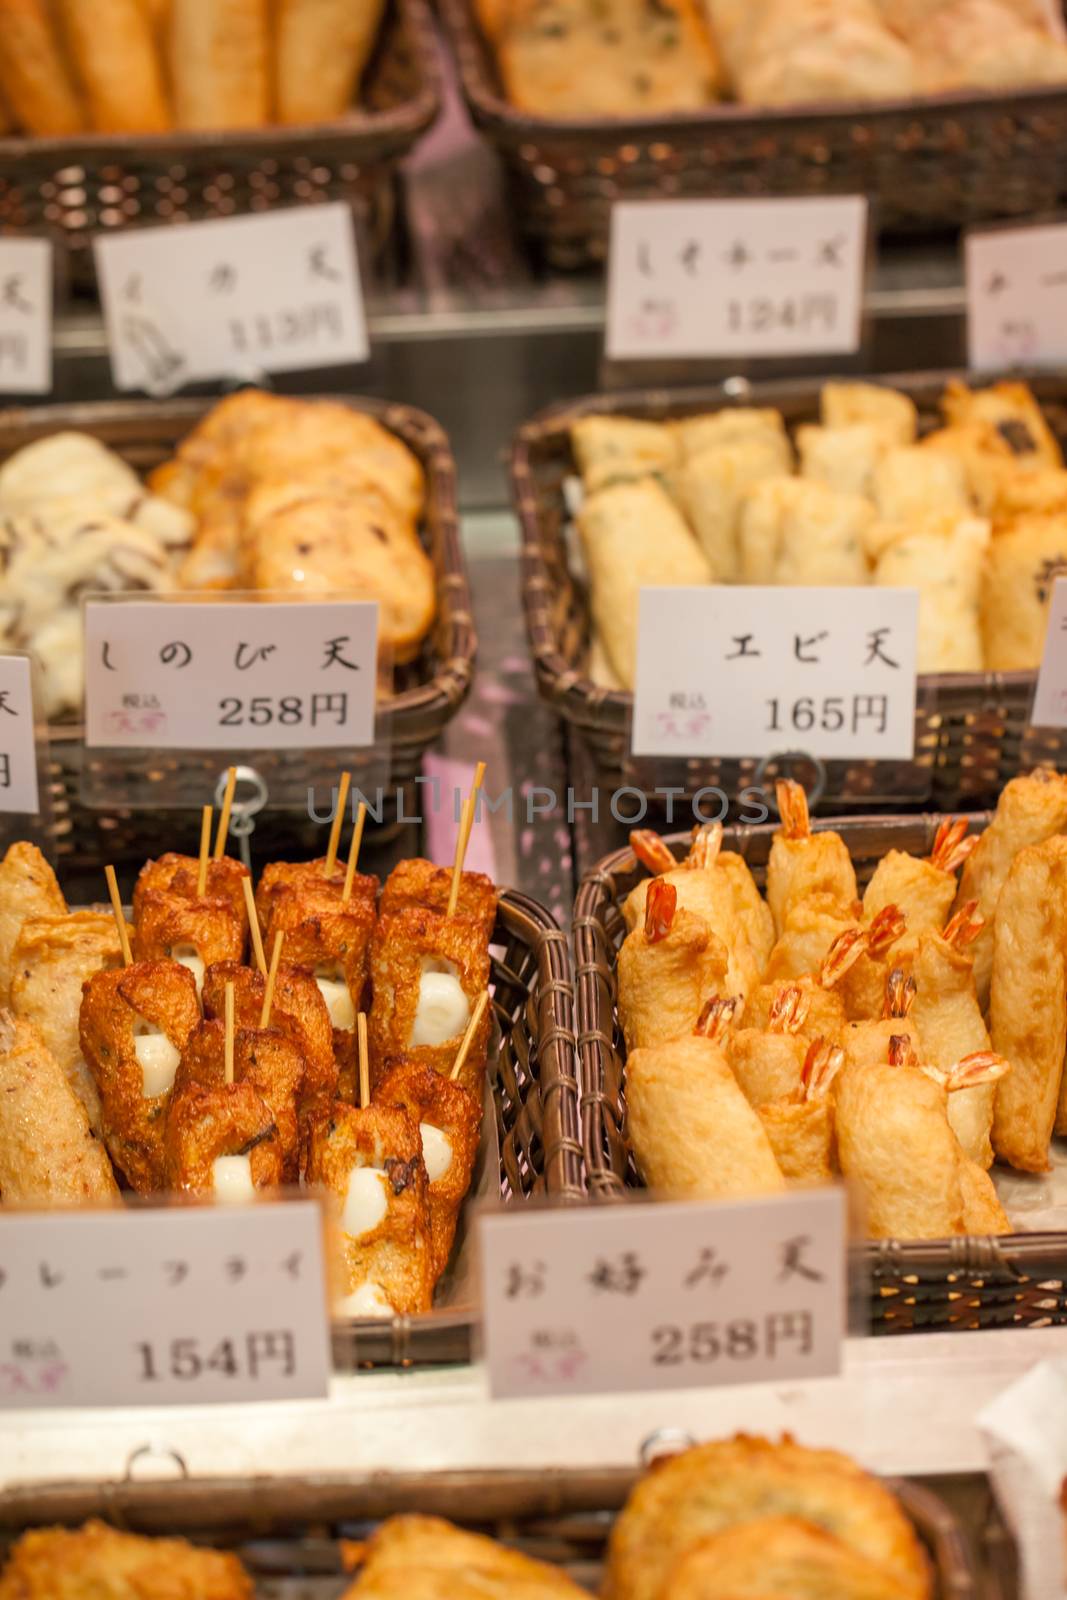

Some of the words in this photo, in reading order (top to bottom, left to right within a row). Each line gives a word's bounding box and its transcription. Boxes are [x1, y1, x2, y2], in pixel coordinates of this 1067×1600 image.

[101, 635, 360, 672] しのび天
[725, 627, 900, 670] エビ天
[218, 692, 348, 727] 258円
[766, 694, 888, 735] 165円
[137, 1329, 296, 1382] 154円
[651, 1310, 813, 1366] 258円
